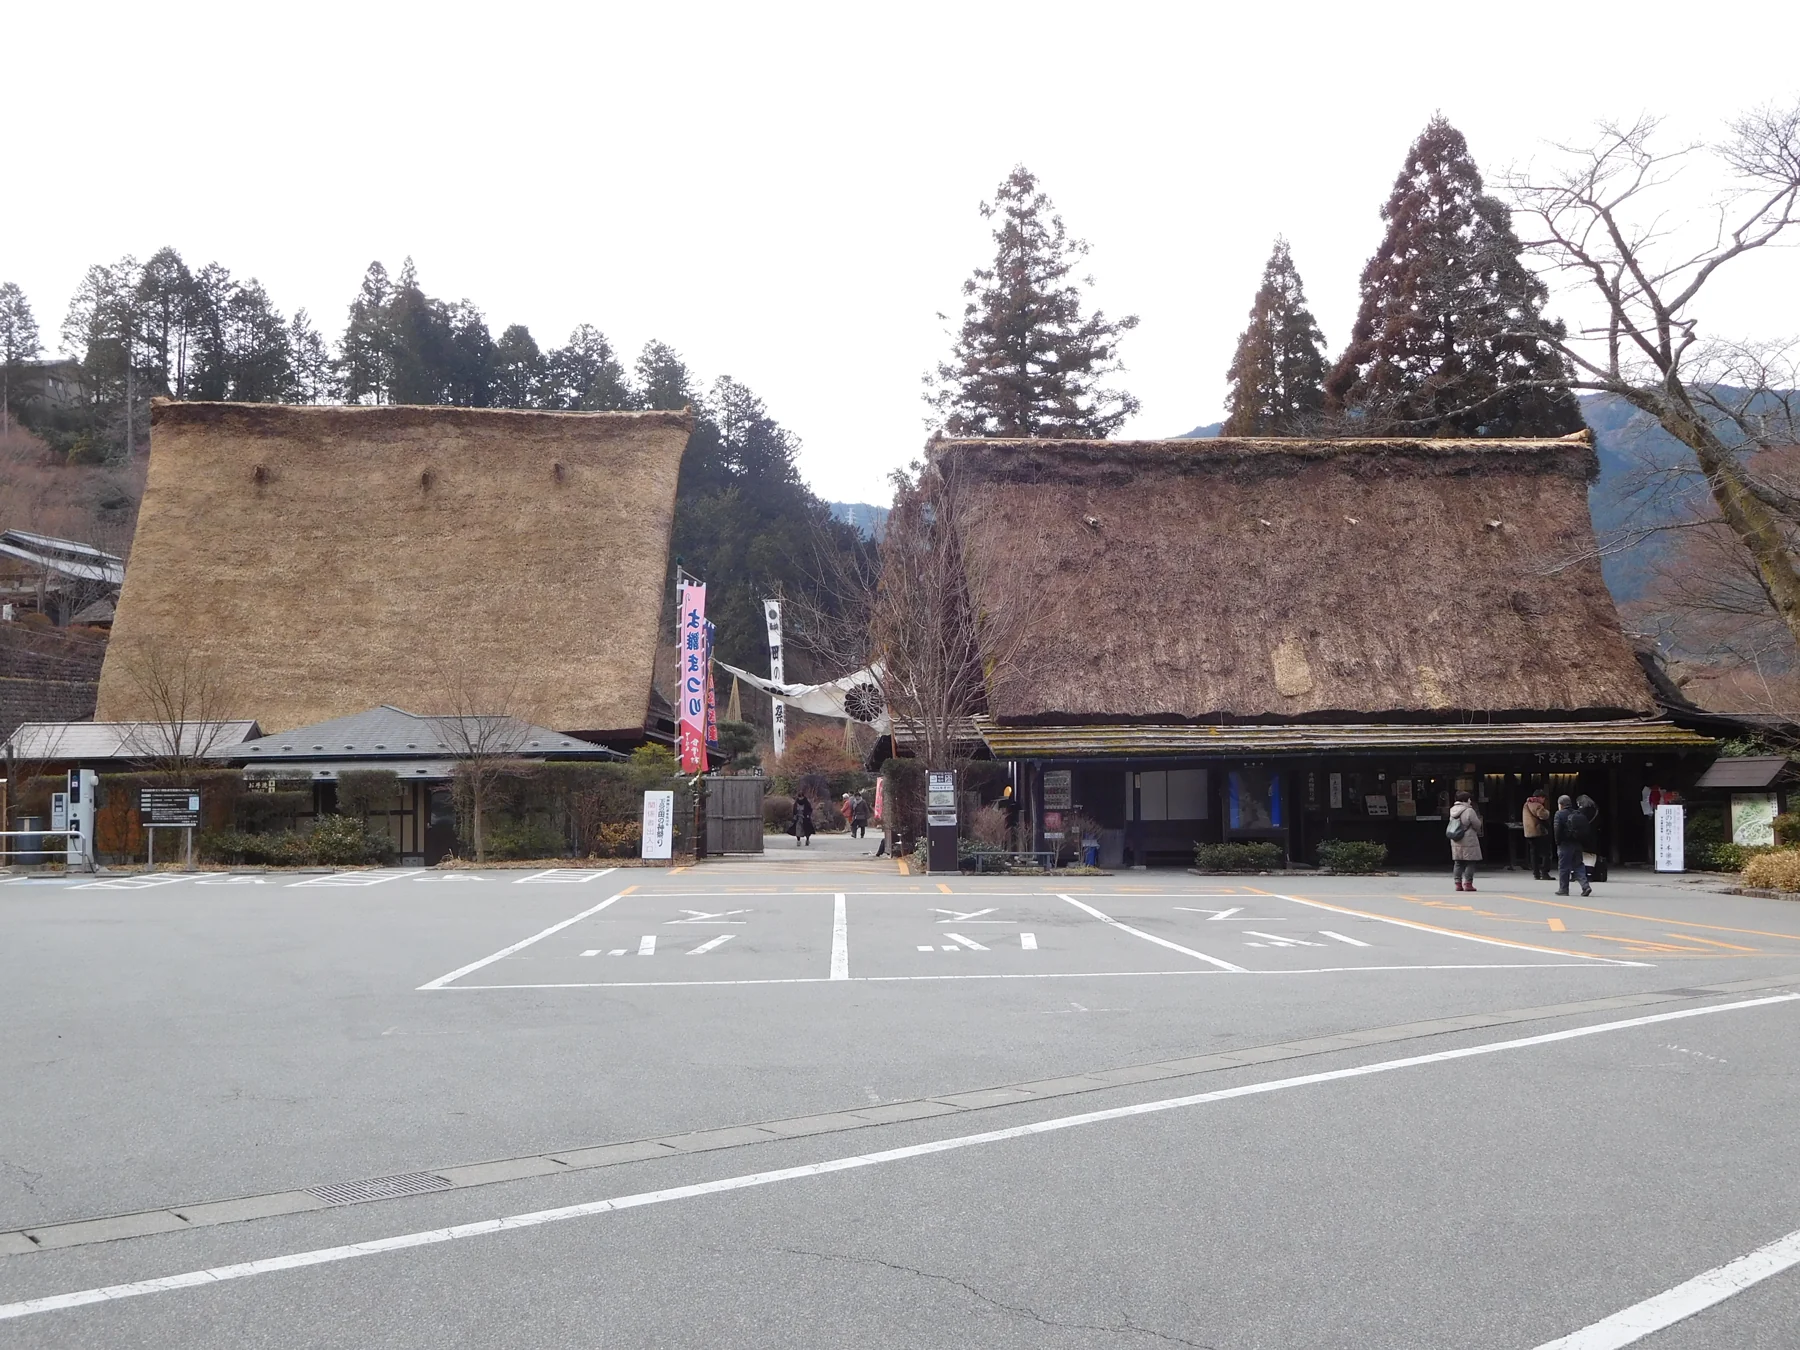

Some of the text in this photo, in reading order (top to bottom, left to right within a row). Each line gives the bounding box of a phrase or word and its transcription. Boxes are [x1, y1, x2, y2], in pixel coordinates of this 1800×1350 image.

[770, 645, 785, 745] 田の祭り
[1533, 752, 1623, 765] 下呂温泉合掌村
